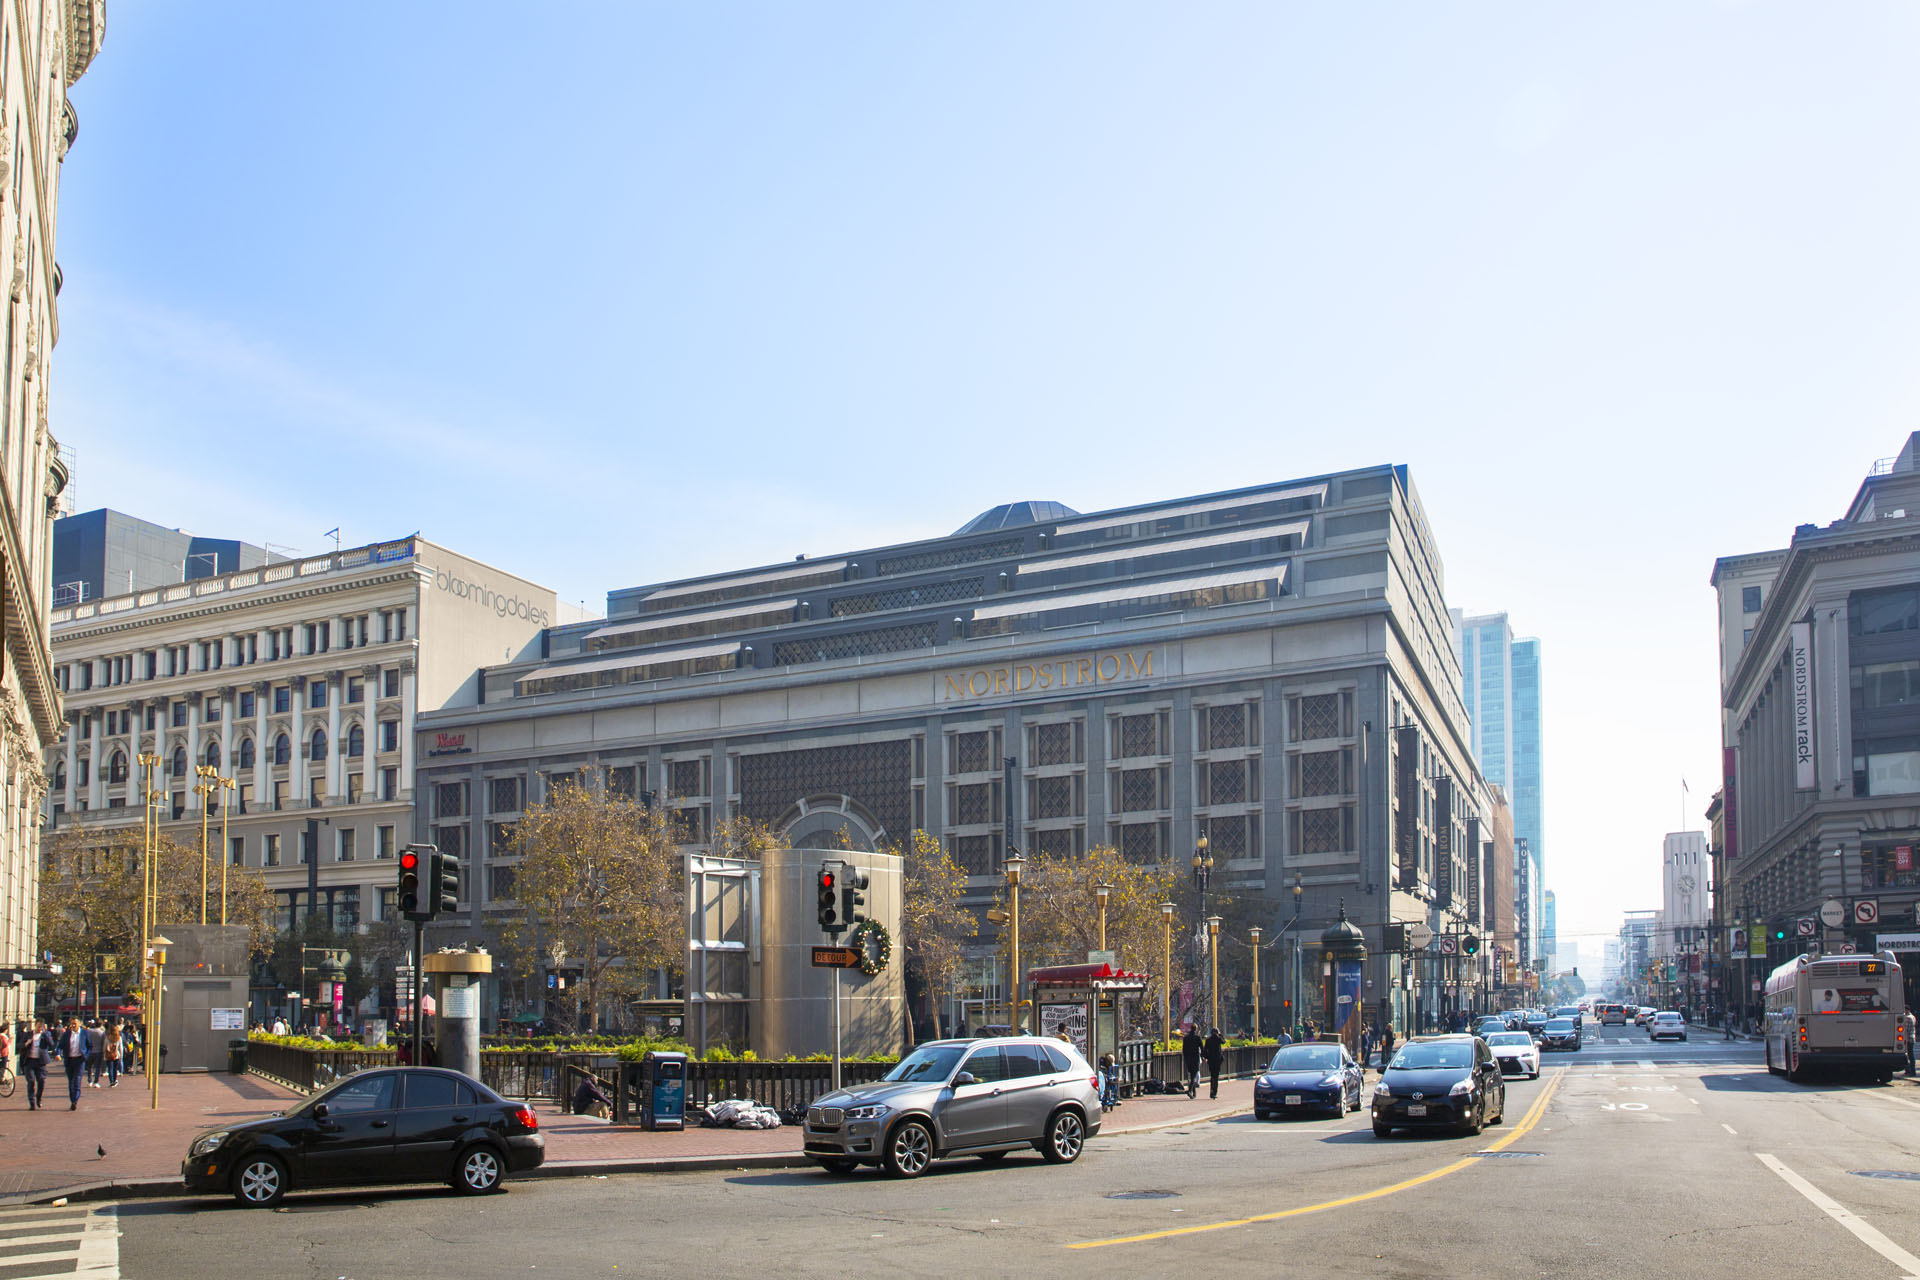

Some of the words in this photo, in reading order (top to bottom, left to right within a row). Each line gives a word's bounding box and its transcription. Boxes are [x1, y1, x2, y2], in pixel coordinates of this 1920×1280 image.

[436, 565, 549, 627] bloomingdale's
[944, 650, 1154, 700] NORDSTROM
[1795, 647, 1807, 727] NORDSTROM
[1797, 729, 1812, 764] rack
[1440, 826, 1449, 896] NORDSTROM
[816, 952, 846, 961] DETOUR
[1867, 963, 1876, 972] 27
